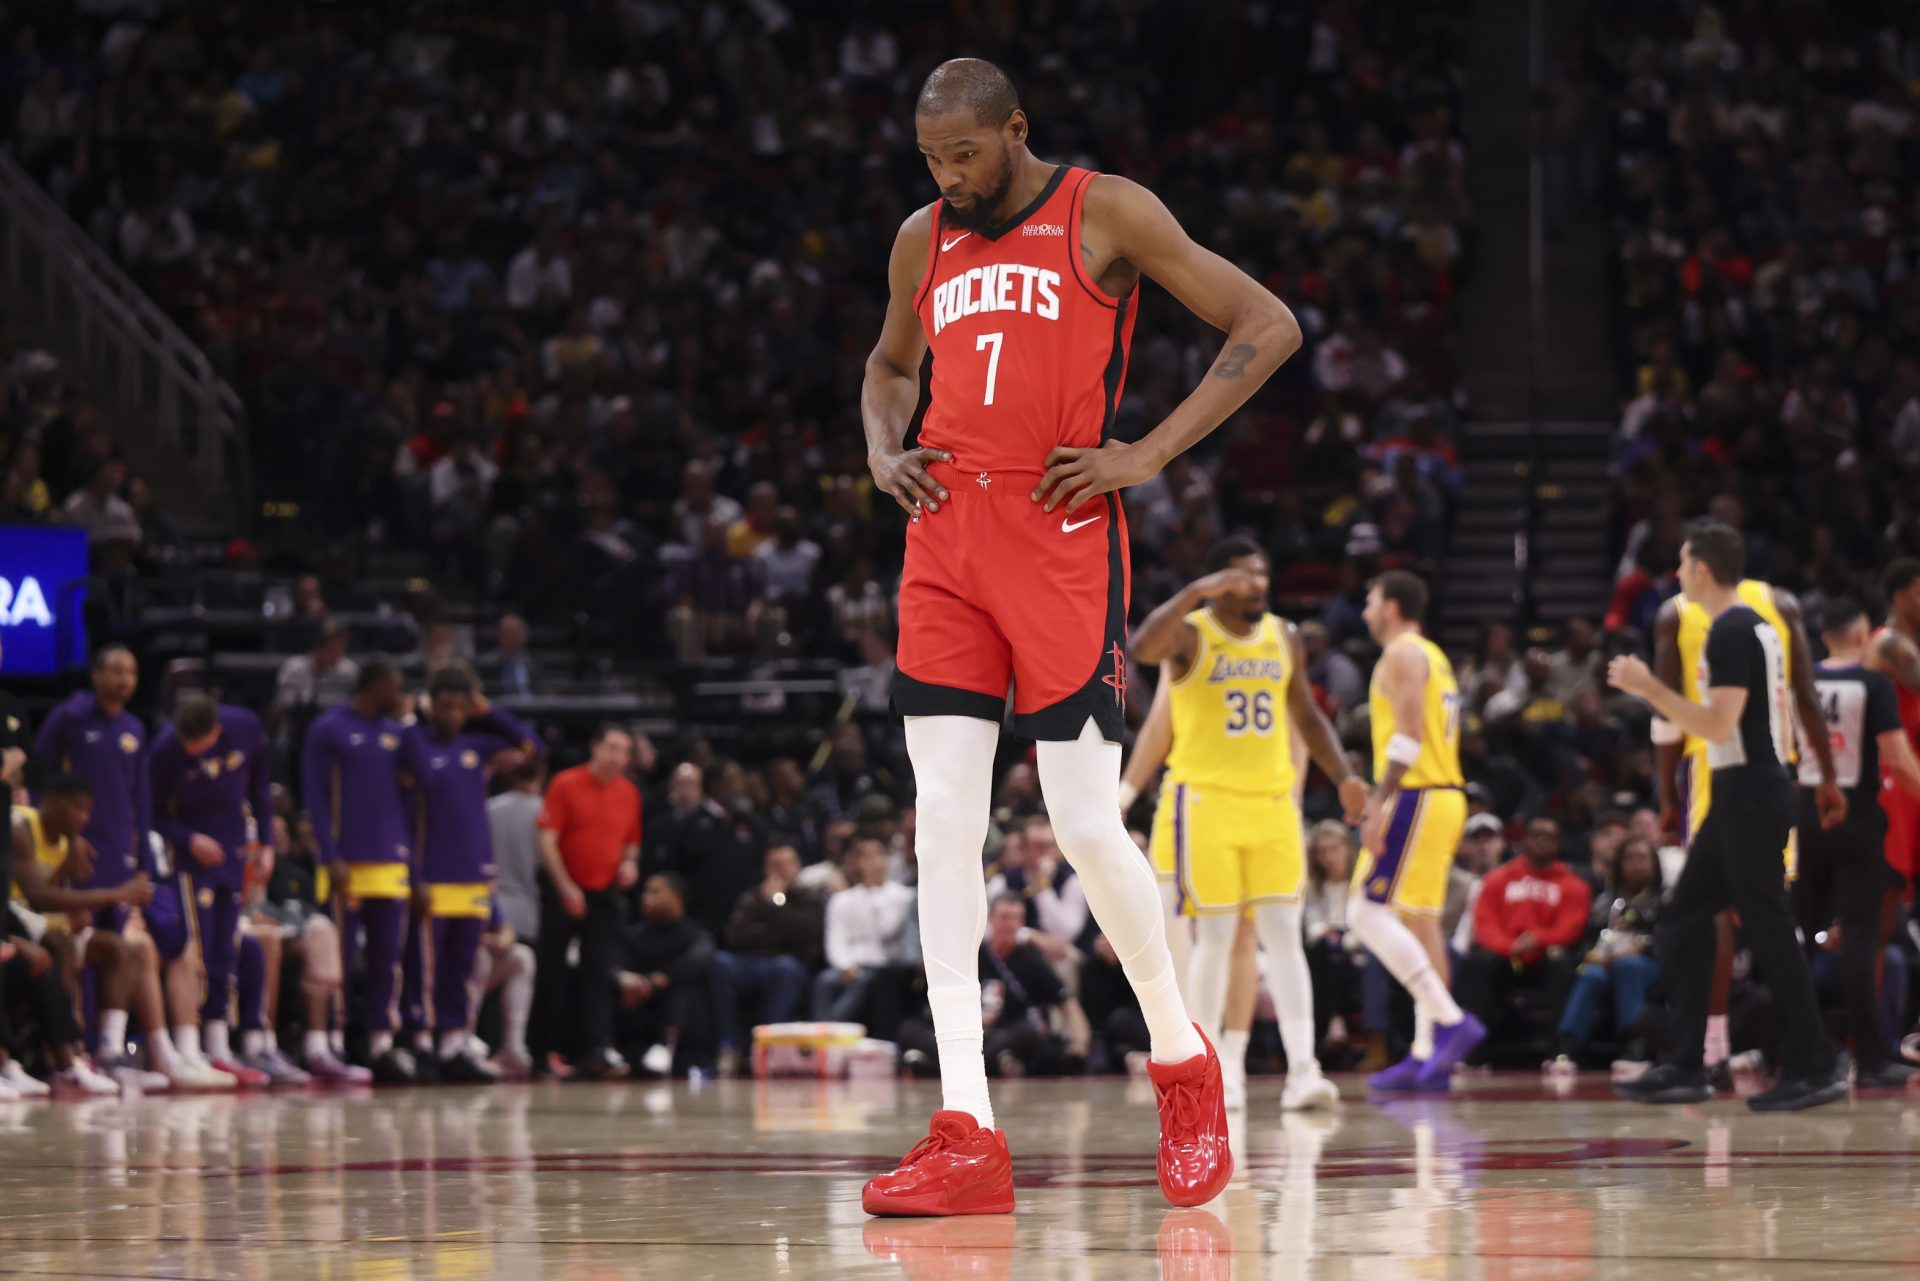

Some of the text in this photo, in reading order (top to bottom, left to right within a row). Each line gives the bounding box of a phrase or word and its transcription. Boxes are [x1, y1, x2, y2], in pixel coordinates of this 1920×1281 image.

[933, 263, 1061, 337] ROCKETS
[976, 332, 1004, 406] 7
[1226, 689, 1273, 734] 36
